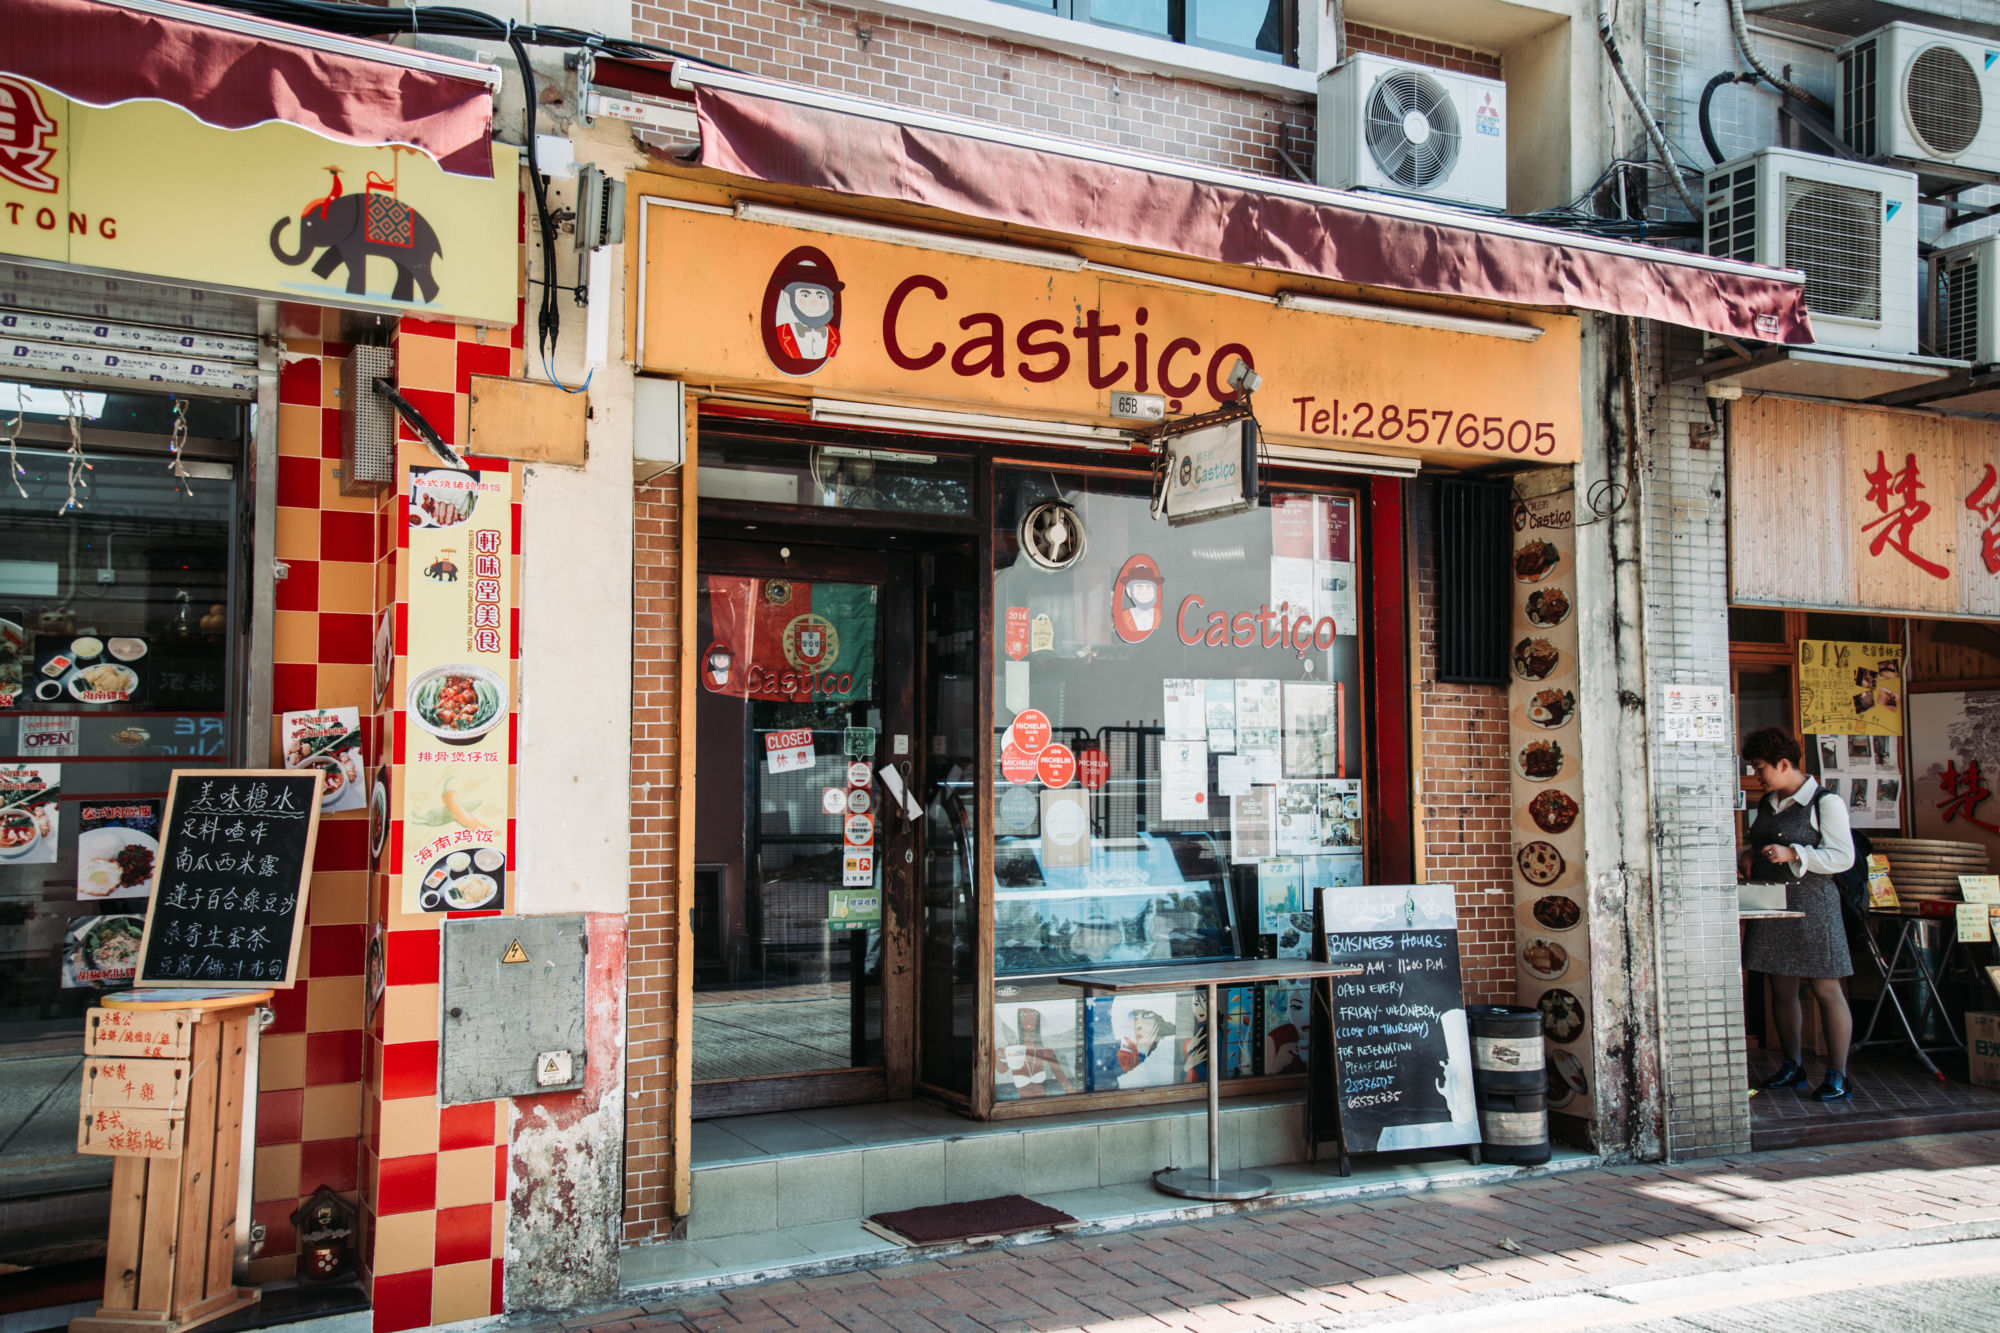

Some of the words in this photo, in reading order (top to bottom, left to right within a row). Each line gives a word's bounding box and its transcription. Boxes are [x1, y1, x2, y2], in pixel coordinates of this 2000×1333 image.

[882, 274, 1255, 414] Castiço
[1118, 397, 1138, 414] 65B
[1194, 462, 1236, 484] Castiço
[1530, 509, 1571, 529] Castiço
[475, 529, 501, 653] 軒味堂美食
[1177, 594, 1336, 659] Castiço
[745, 662, 853, 699] Castiço
[26, 732, 71, 747] OPEN
[767, 731, 812, 749] CLOSED
[417, 751, 499, 763] 排骨煲仔饭
[1079, 760, 1108, 768] MICHELIN
[193, 781, 296, 811] 美味糖水
[413, 829, 495, 865] 海南鸡饭
[176, 846, 280, 877] 南瓜西米露
[1330, 934, 1394, 955] BUSINESS
[1337, 982, 1365, 997] OPEN
[1369, 981, 1404, 997] EVERY
[1345, 1061, 1373, 1075] PLEASE
